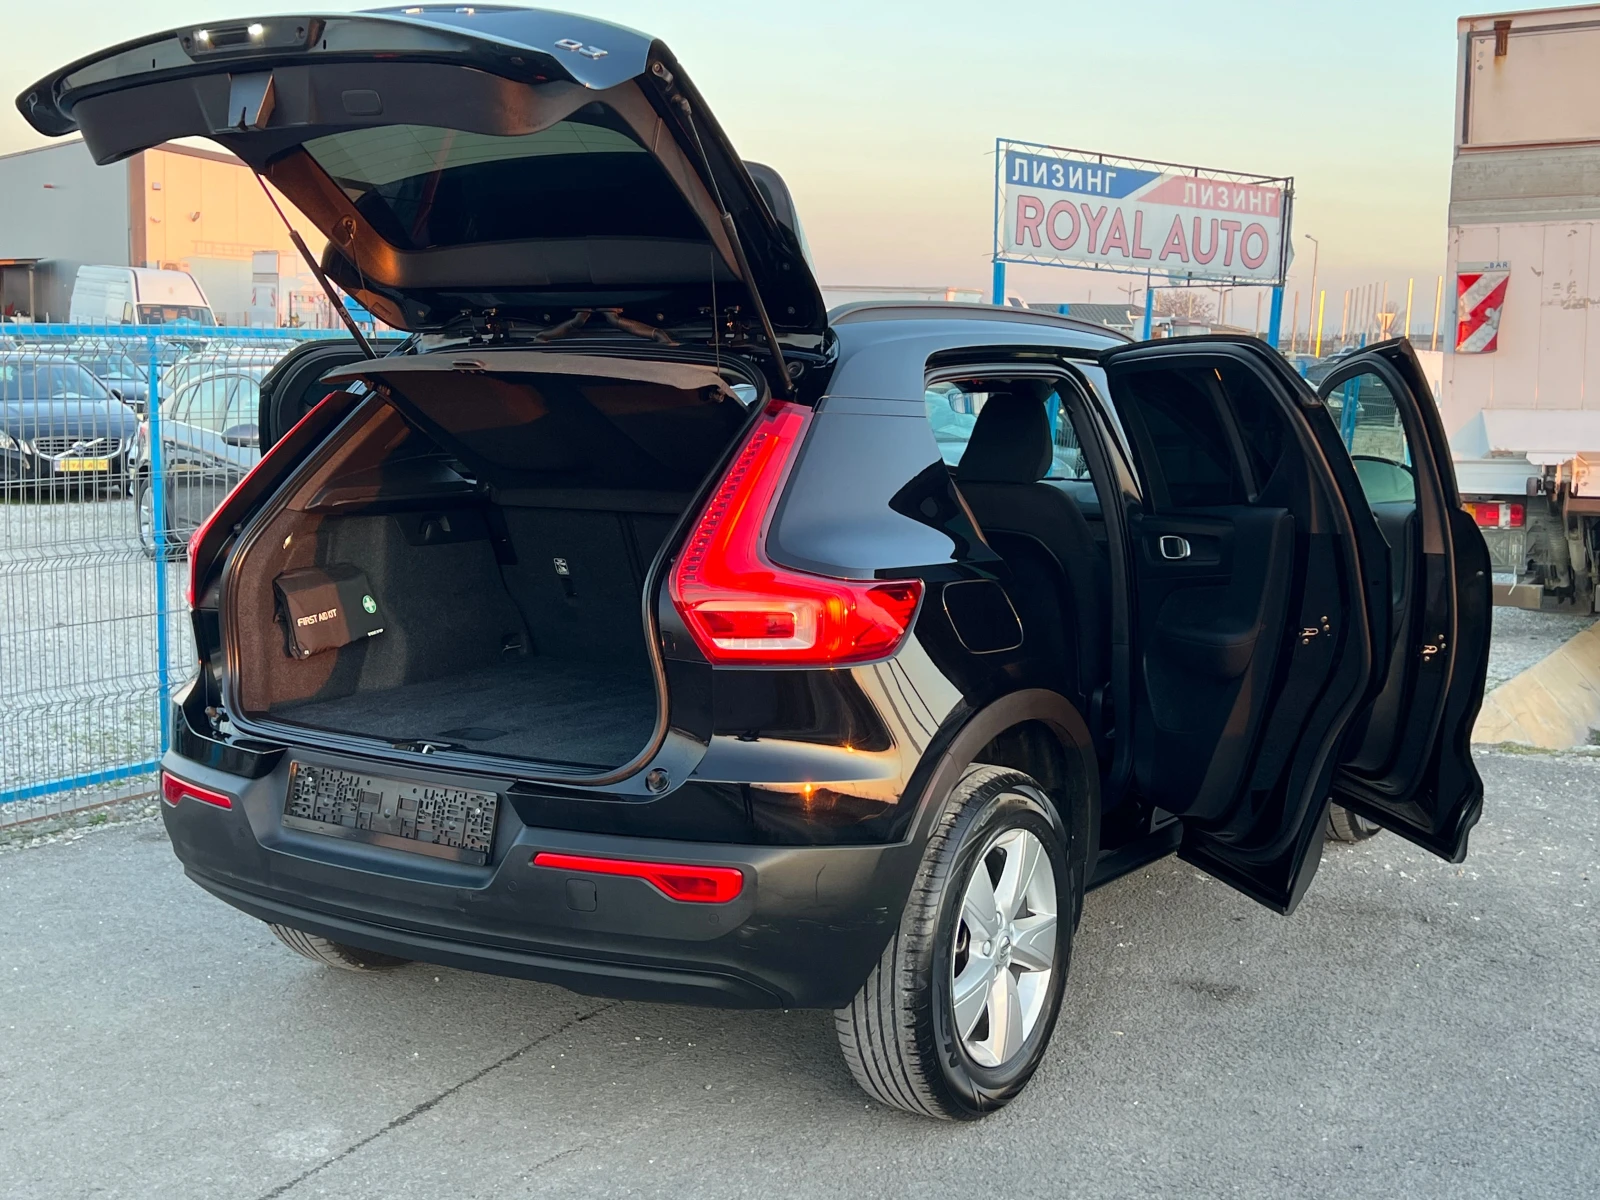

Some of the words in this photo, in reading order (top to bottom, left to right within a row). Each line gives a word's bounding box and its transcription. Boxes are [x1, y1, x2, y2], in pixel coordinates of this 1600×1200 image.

[1012, 158, 1117, 194] ЛИЗИНГ
[1183, 183, 1276, 213] ЛИЗИНГ
[1015, 195, 1152, 260] ROYAL
[1159, 213, 1269, 270] AUTO
[297, 614, 318, 627] FIRST
[318, 611, 328, 622] AID
